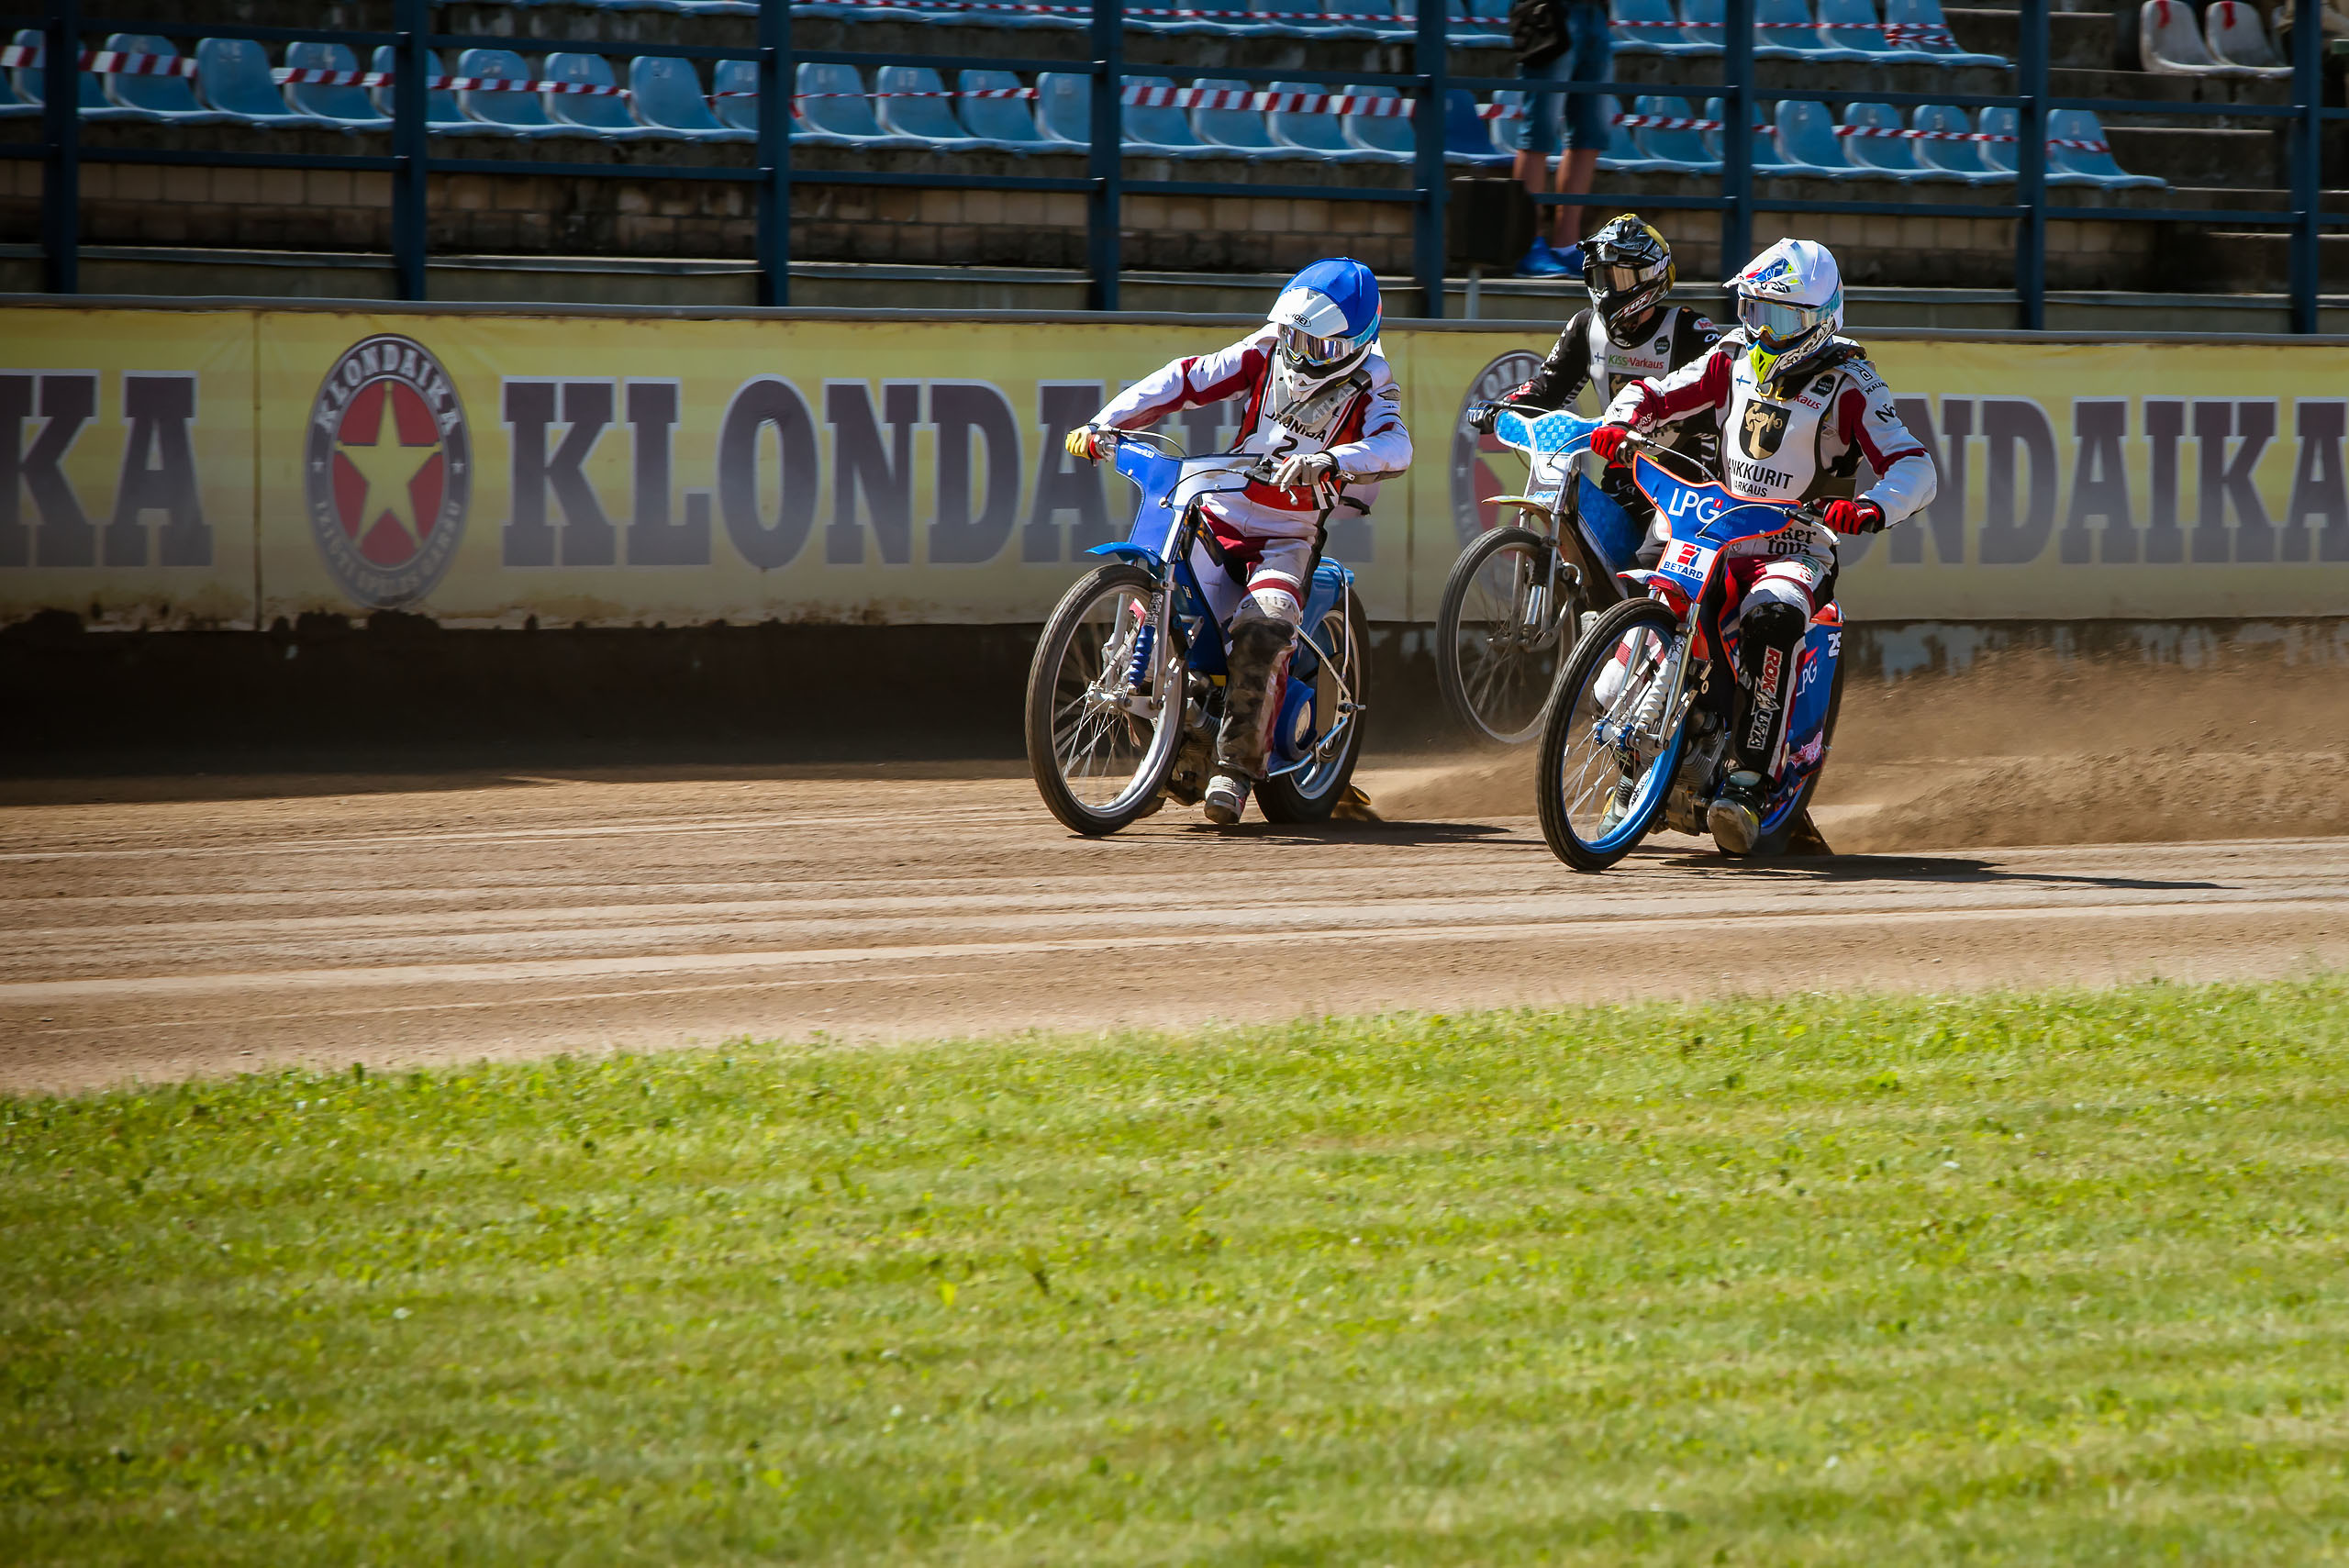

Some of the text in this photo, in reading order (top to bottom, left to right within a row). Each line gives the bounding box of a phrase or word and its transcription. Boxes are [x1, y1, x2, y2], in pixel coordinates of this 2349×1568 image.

[315, 344, 461, 435] KLONDAIKA
[1794, 392, 1822, 410] kaus
[1271, 434, 1299, 460] 2
[1734, 480, 1768, 497] ARKAUS
[1838, 393, 2349, 567] NDAIKA
[1668, 488, 1721, 525] LPG
[1763, 527, 1818, 545] ker
[1664, 560, 1705, 581] BETARD
[1761, 644, 1783, 697] ROK
